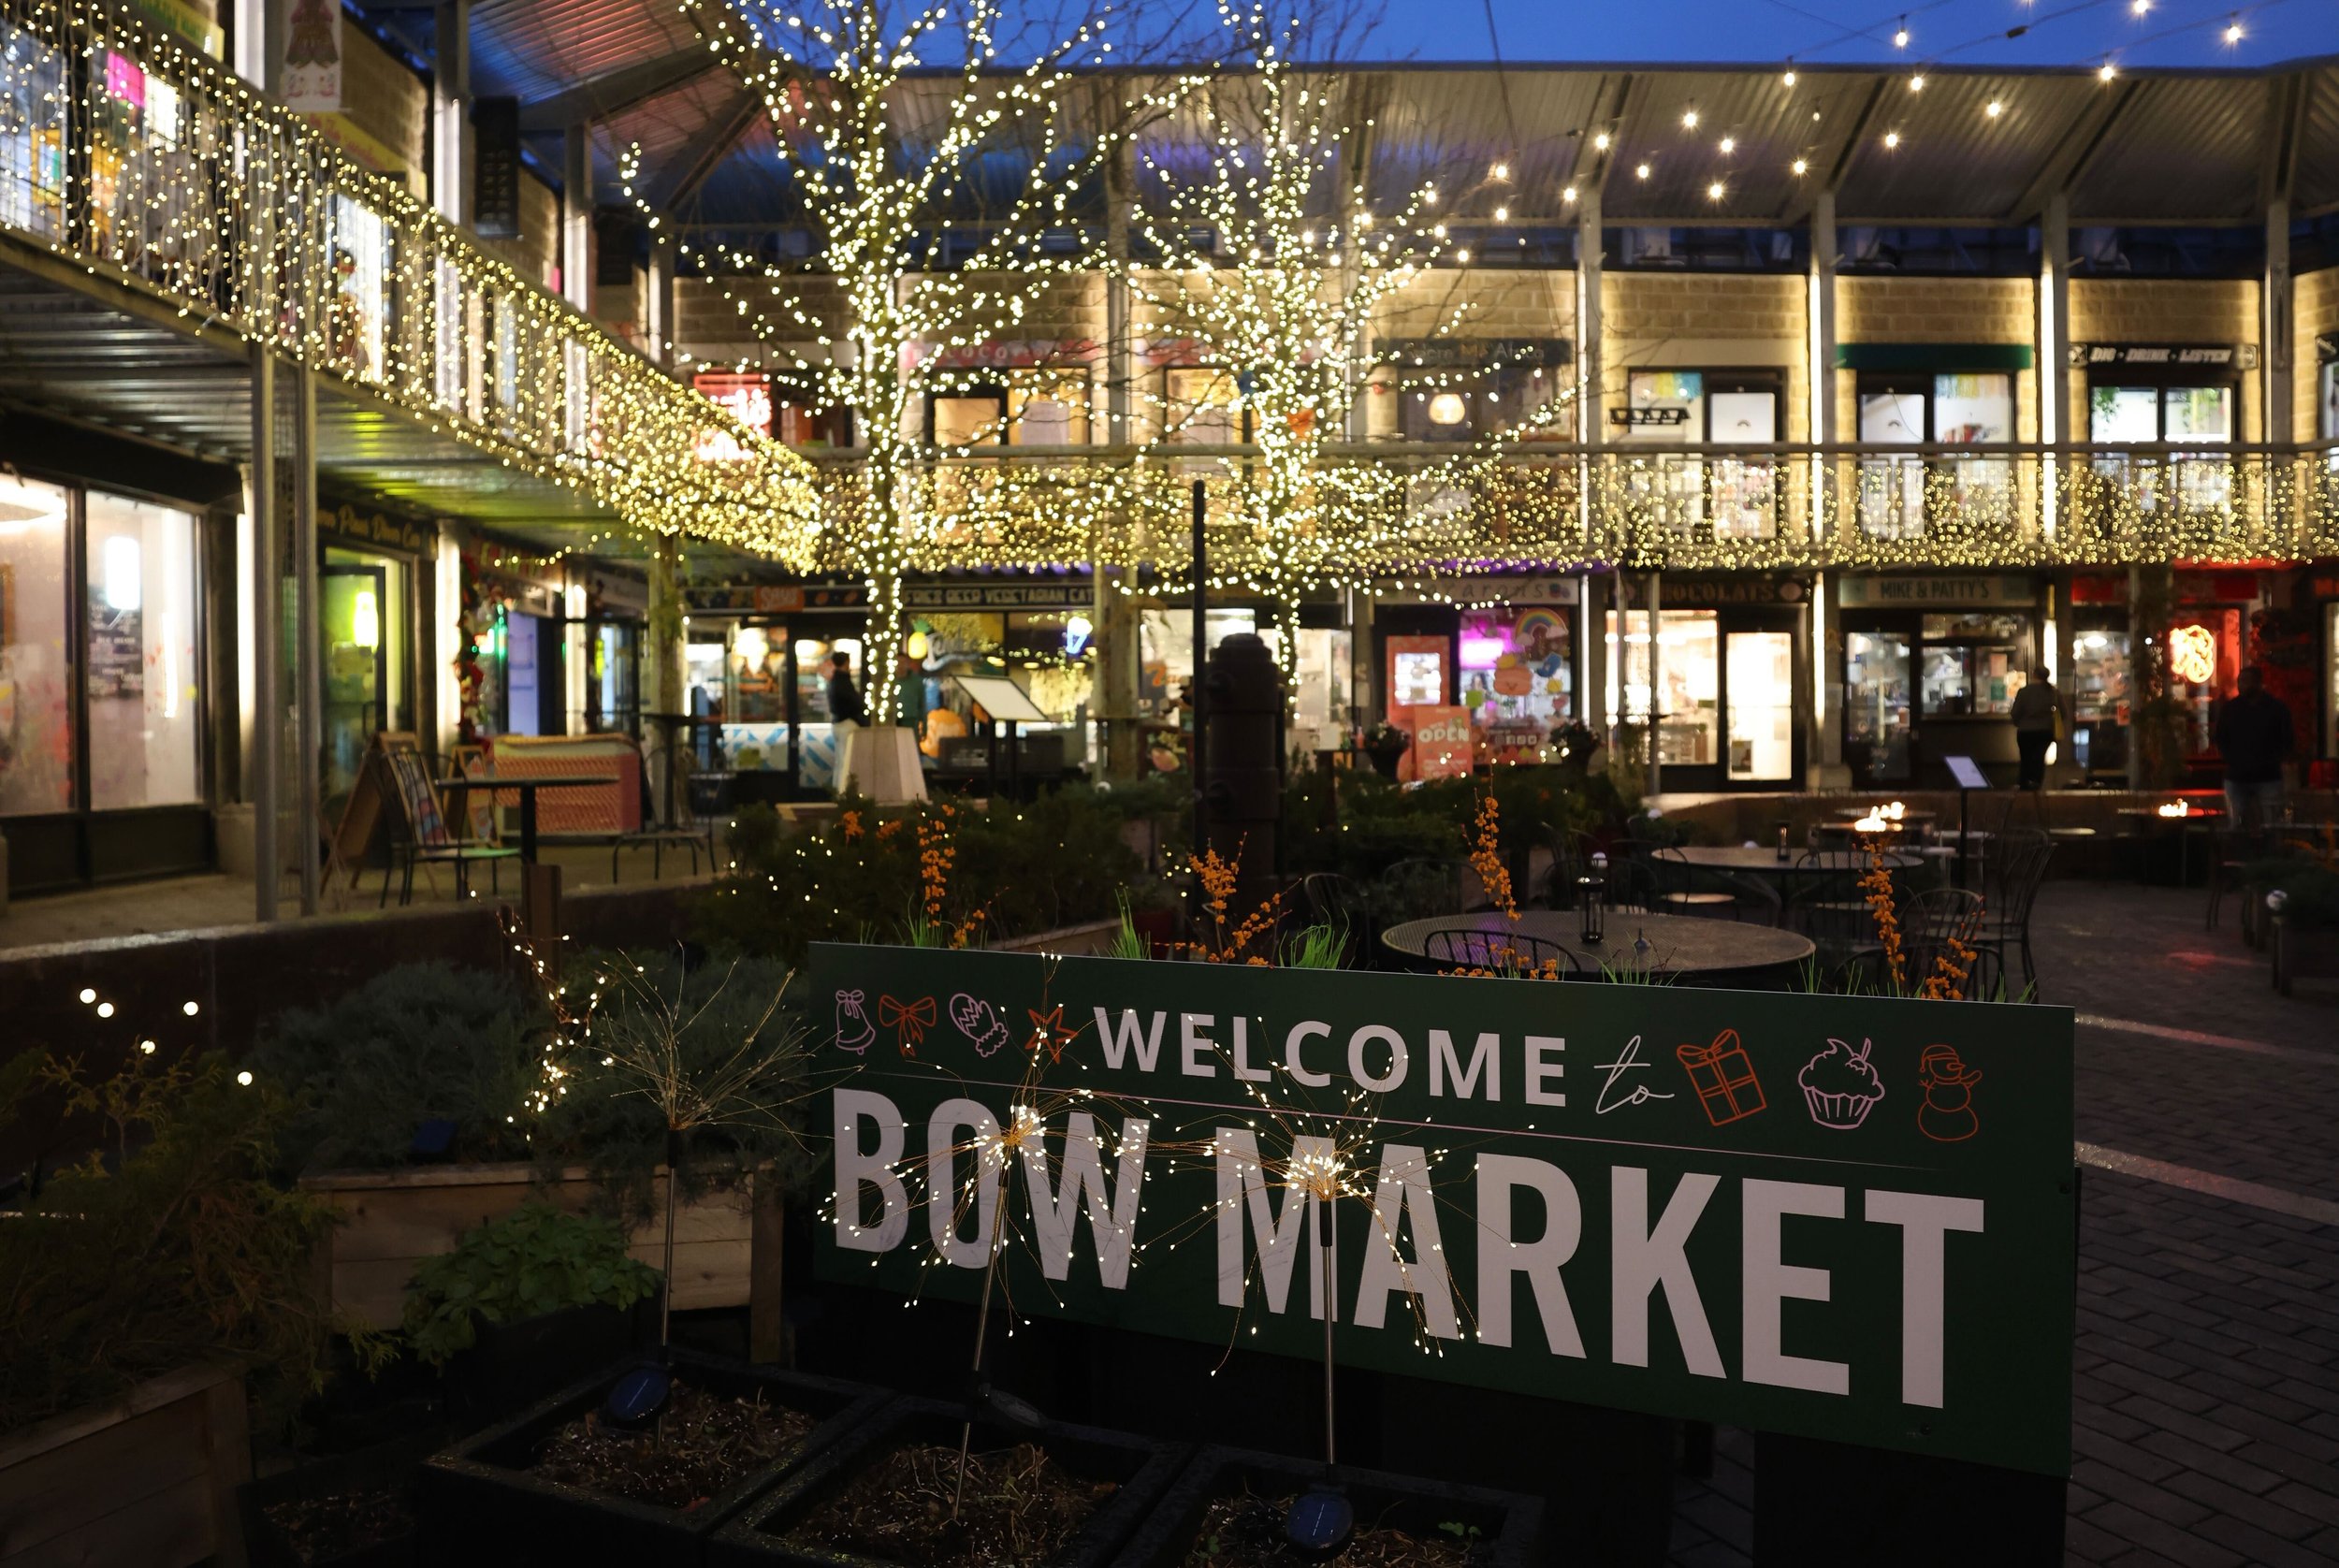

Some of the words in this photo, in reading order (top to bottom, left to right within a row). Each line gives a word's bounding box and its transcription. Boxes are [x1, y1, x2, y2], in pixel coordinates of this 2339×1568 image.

[2089, 346, 2116, 363] DIG
[2125, 347, 2171, 363] DRINK
[2178, 348, 2232, 364] LISTEN
[985, 588, 1067, 604] VEGETARIAN
[1881, 580, 1913, 599] MIKE
[1916, 580, 1927, 599] &
[1931, 578, 1989, 599] PATTY'S
[1418, 726, 1469, 743] OPEN
[1093, 1006, 1566, 1107] WELCOME
[1594, 1034, 1675, 1114] to
[834, 1087, 1151, 1291] BOW
[1216, 1125, 1984, 1409] MARKET
